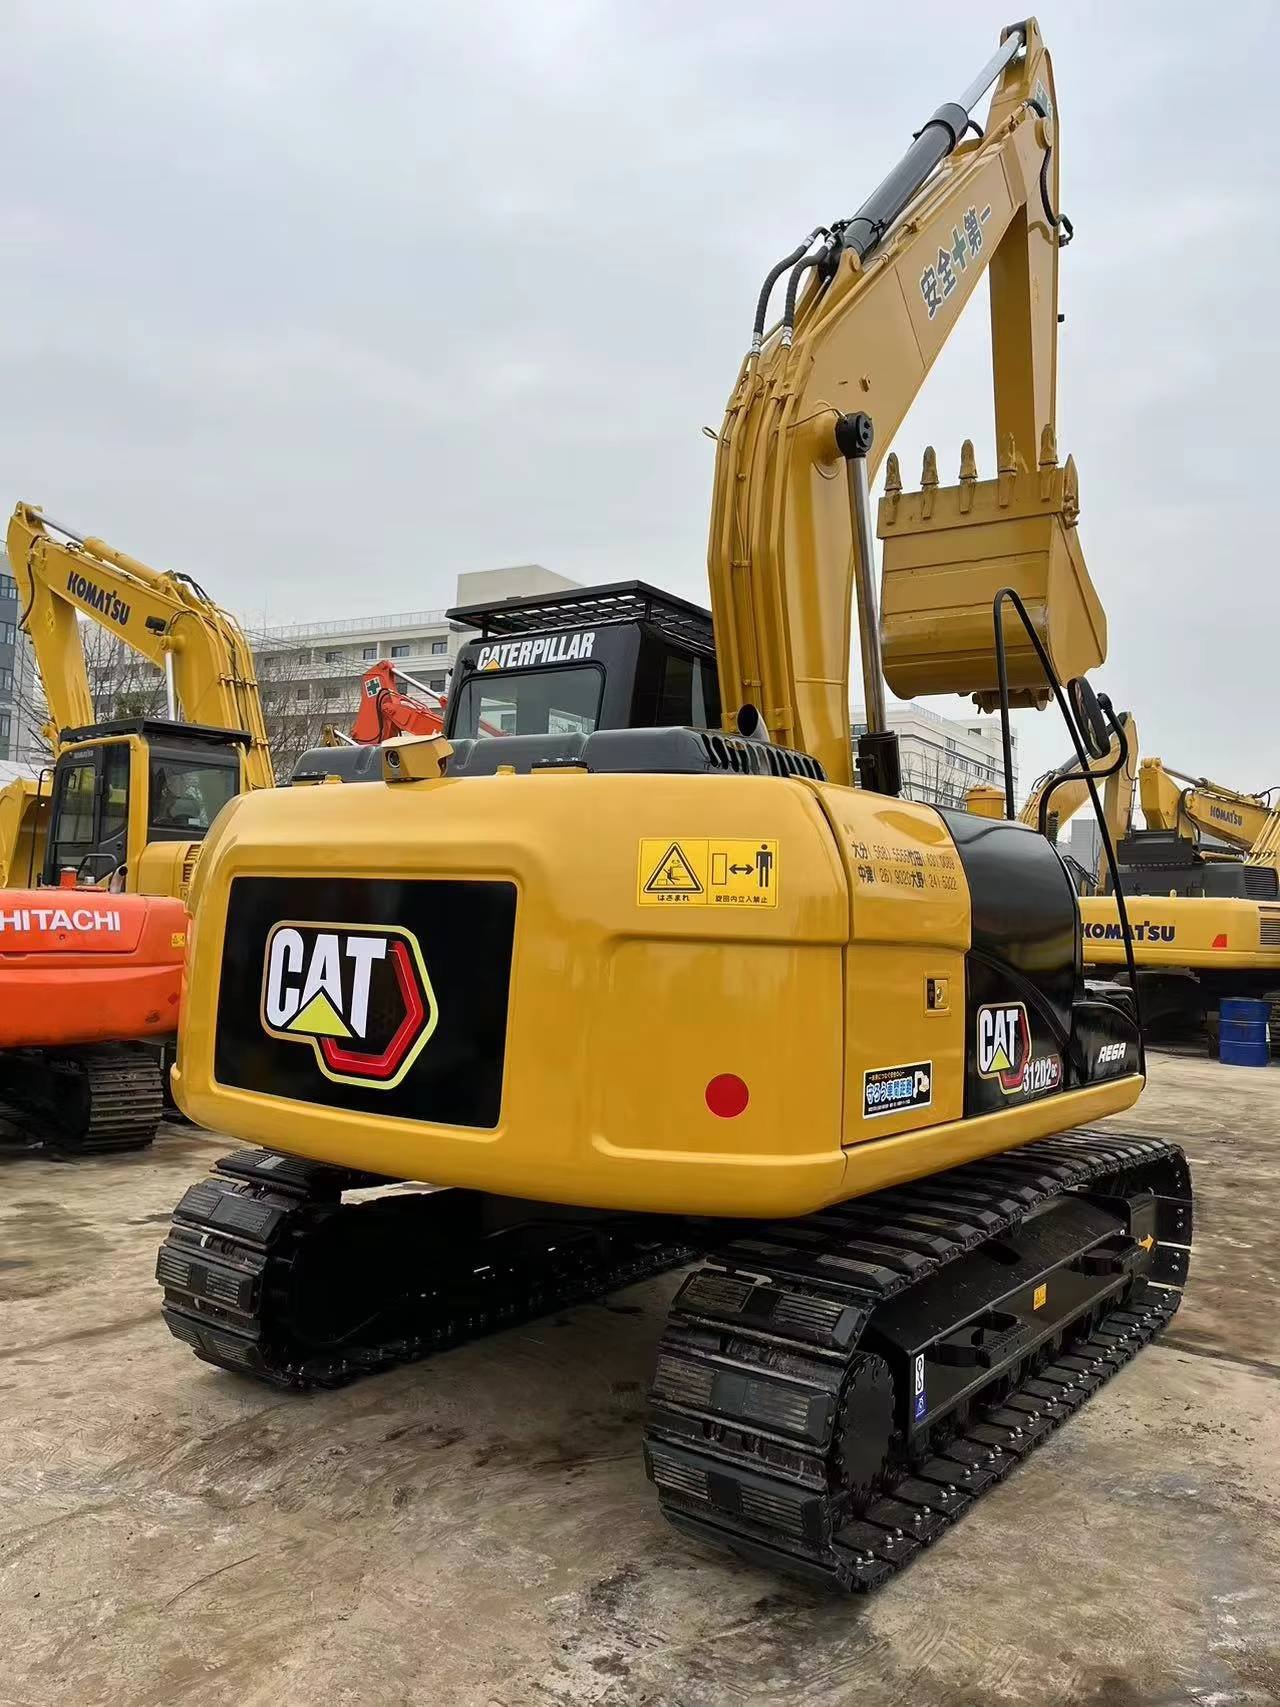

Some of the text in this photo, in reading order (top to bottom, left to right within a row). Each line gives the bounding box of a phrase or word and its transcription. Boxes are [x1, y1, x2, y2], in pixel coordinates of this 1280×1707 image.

[920, 204, 992, 320] 安全 第一
[67, 570, 132, 626] KOMATSU
[477, 632, 596, 671] CATERPILLAR
[1210, 805, 1243, 827] KOMATSU
[0, 908, 121, 932] HITACHI
[657, 894, 690, 902] はさまれ
[266, 928, 388, 1039] CAT
[979, 1009, 1019, 1072] CAT
